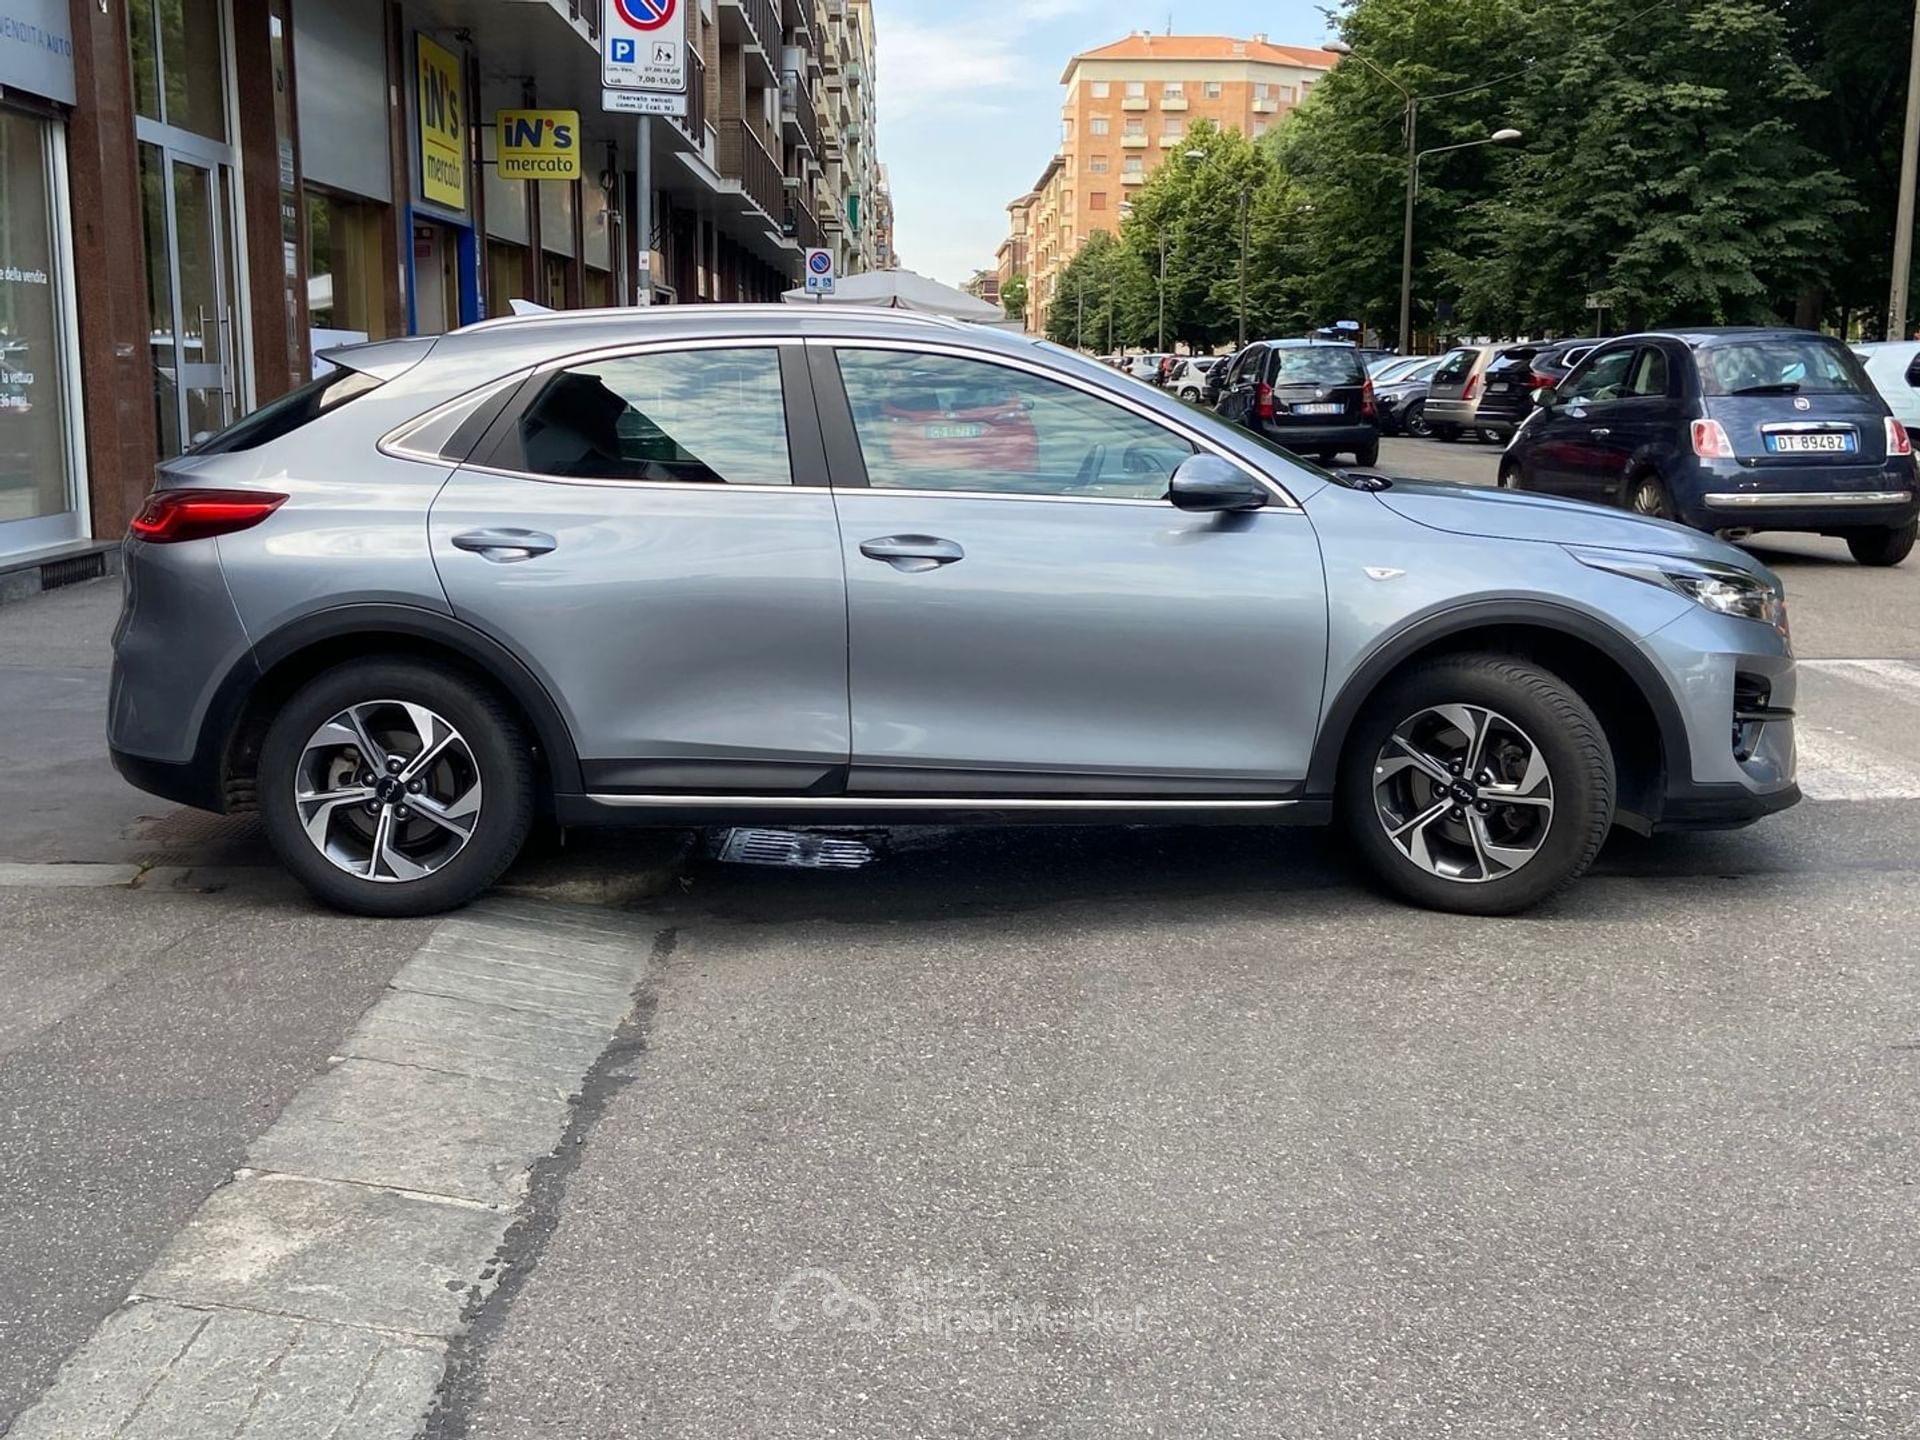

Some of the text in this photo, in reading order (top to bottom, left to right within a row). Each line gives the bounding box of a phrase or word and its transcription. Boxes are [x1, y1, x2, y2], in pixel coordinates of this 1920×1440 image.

[46, 32, 72, 57] AUTO
[616, 41, 630, 60] P
[423, 58, 459, 140] iN's
[617, 94, 648, 102] riservato
[504, 116, 572, 149] iN's
[428, 154, 461, 190] mercato
[505, 156, 573, 172] mercato
[5, 266, 22, 281] della
[22, 269, 48, 284] vendita
[1778, 436, 1795, 450] DT
